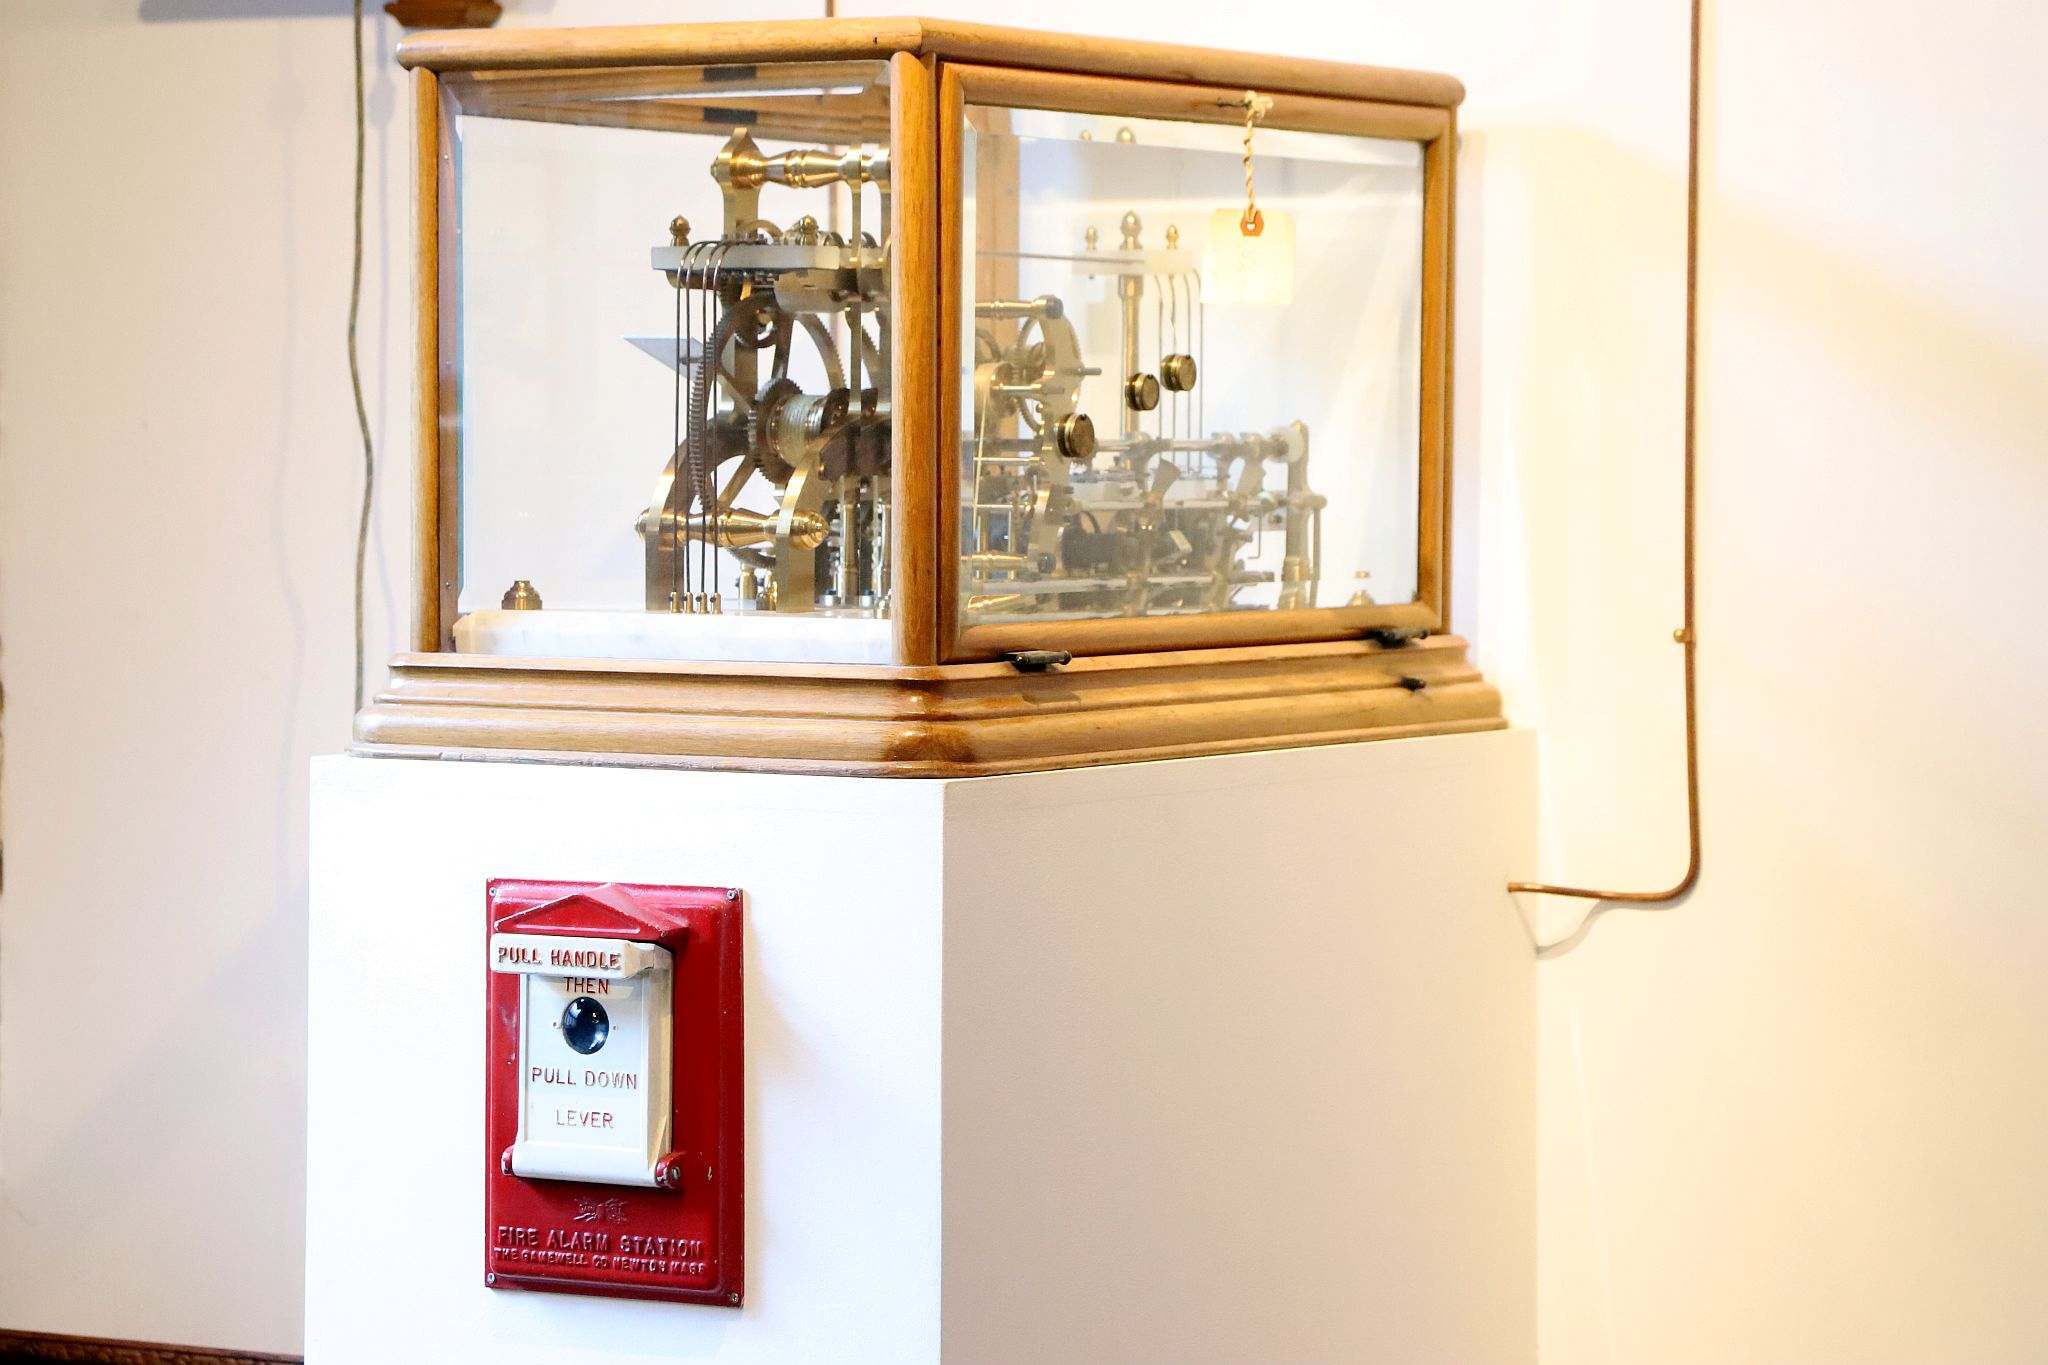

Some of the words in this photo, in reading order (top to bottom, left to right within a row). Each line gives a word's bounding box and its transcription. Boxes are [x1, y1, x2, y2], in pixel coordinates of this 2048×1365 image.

[498, 947, 541, 965] PULL
[551, 949, 620, 969] HANDLE
[564, 977, 609, 995] THEN
[532, 1067, 576, 1086] PULL
[585, 1070, 637, 1090] DOWN
[556, 1109, 613, 1129] LEVER
[498, 1226, 539, 1246] FIRE
[548, 1229, 608, 1252] ALARM
[620, 1235, 703, 1258] STATION
[494, 1247, 518, 1260] THE
